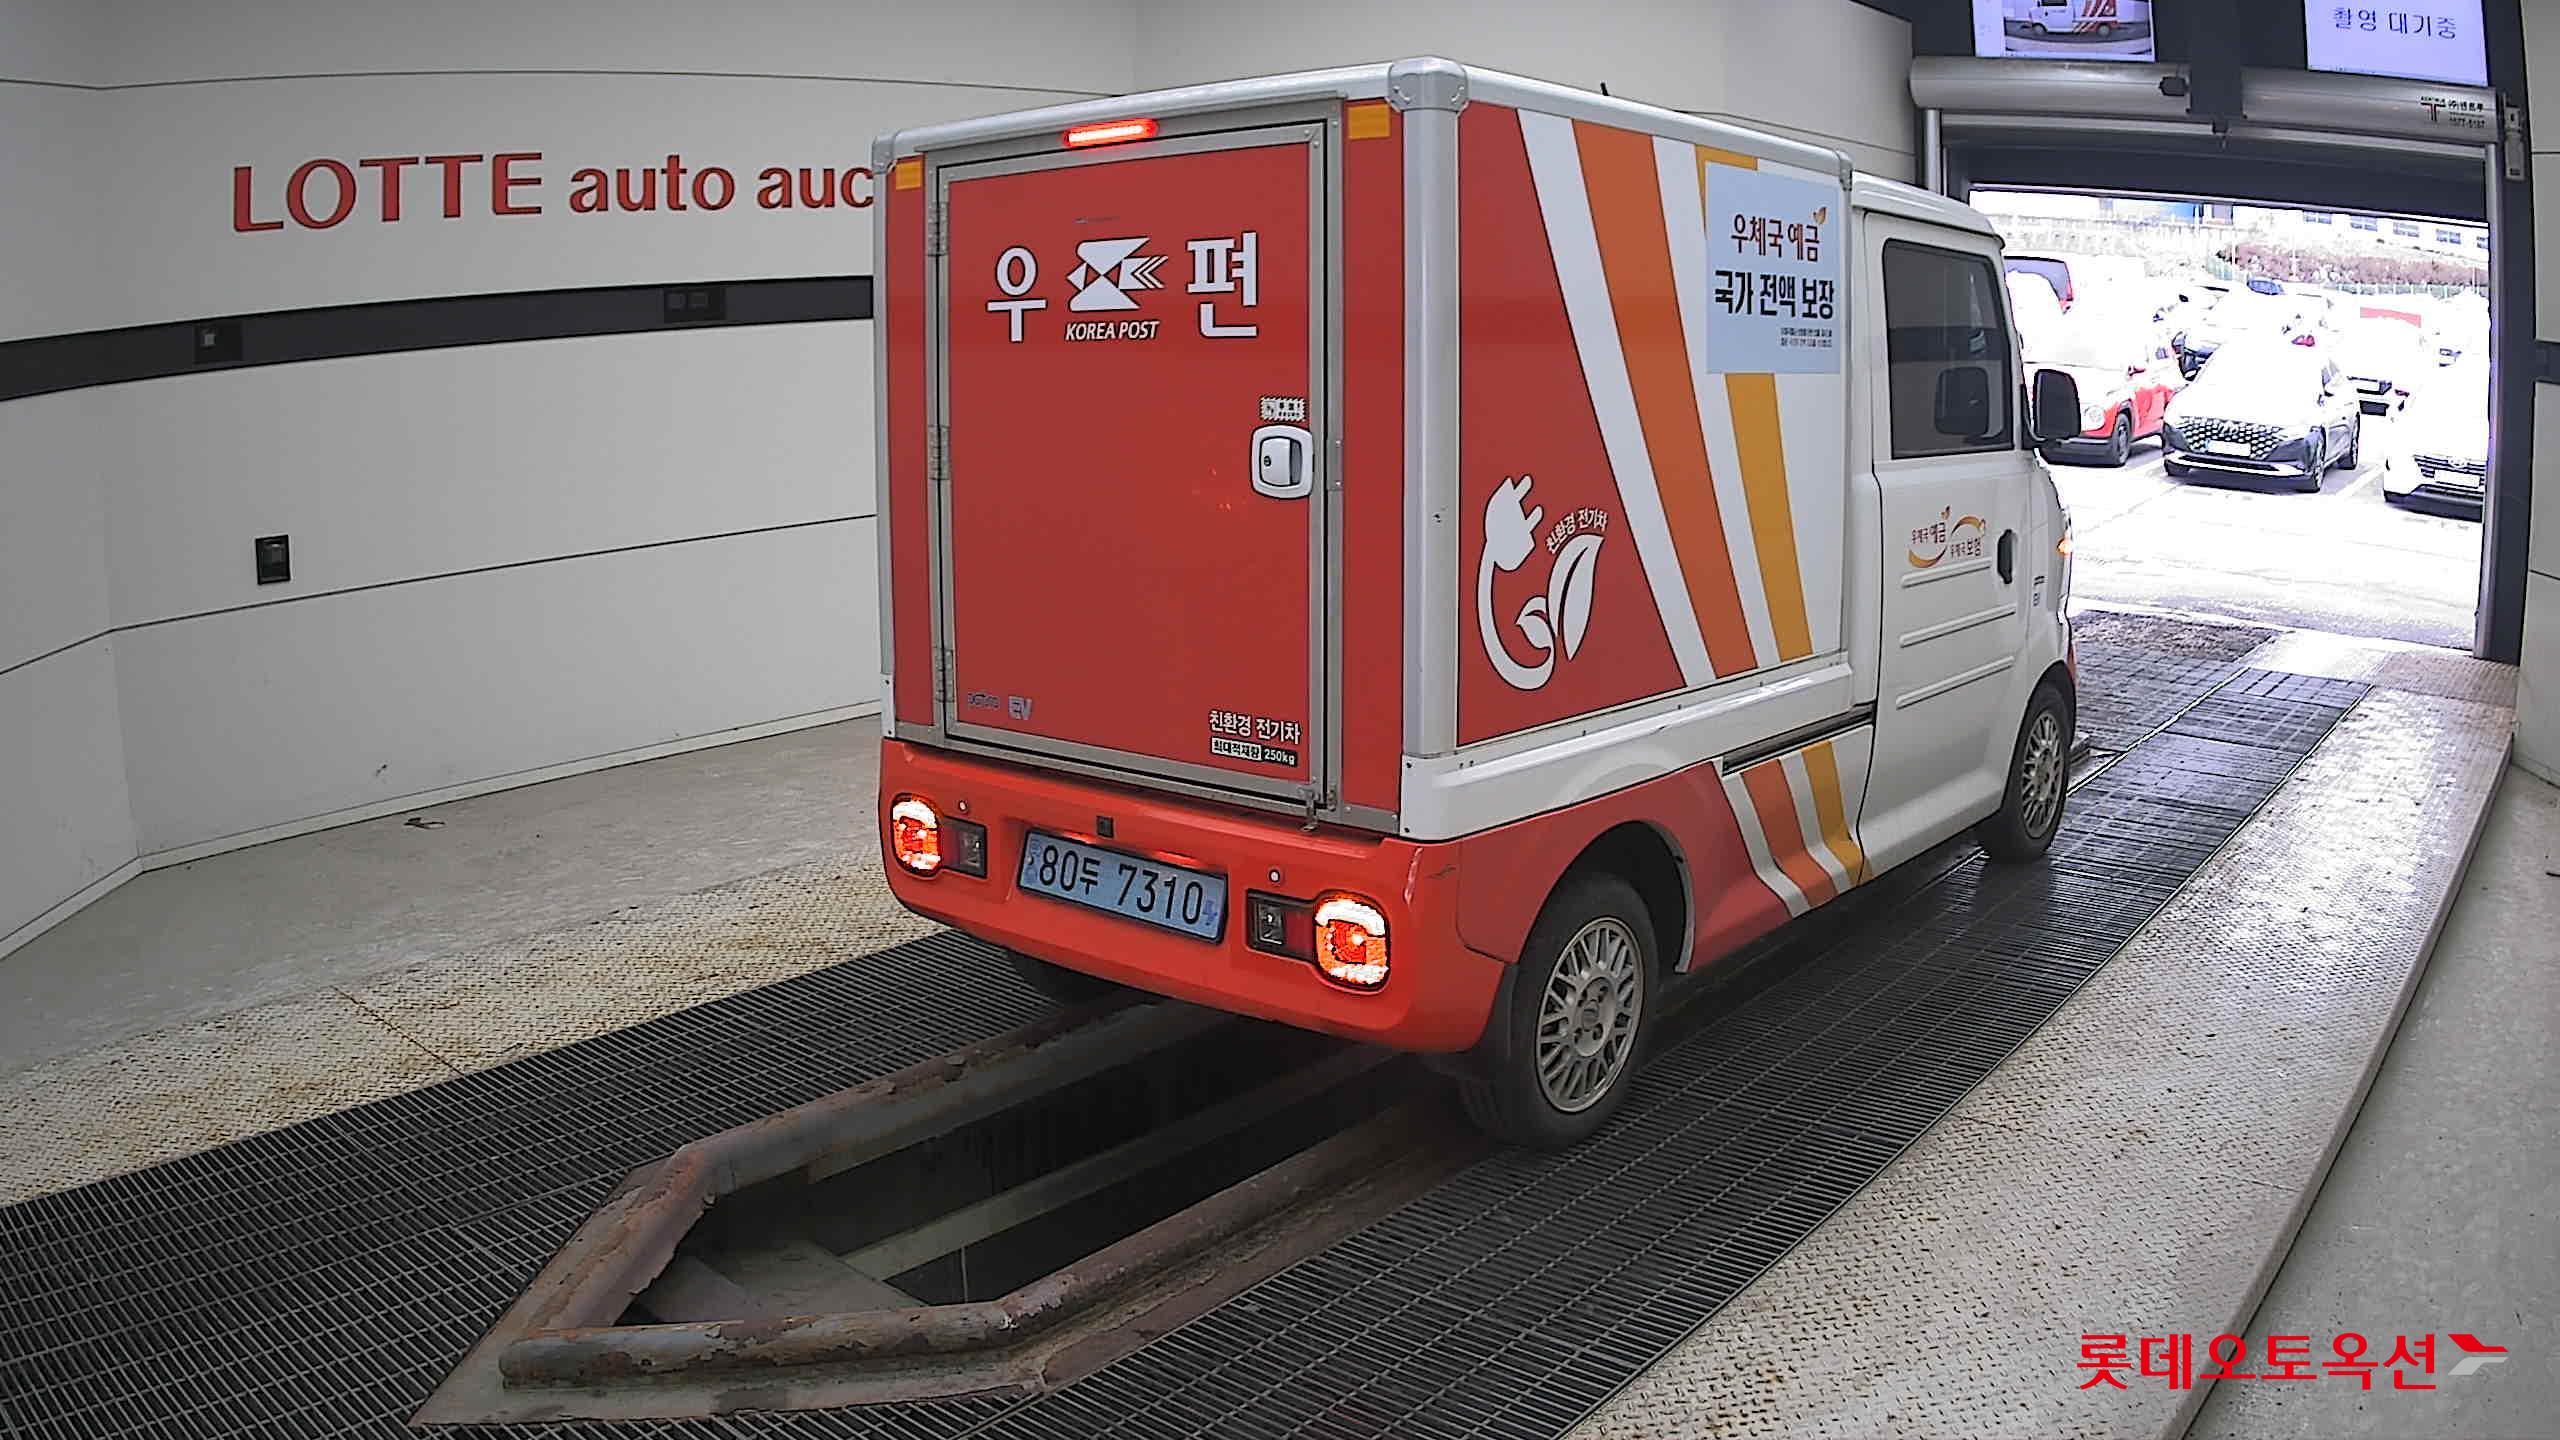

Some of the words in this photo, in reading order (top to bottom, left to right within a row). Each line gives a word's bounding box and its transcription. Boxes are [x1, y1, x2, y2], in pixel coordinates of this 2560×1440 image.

[2388, 12, 2457, 40] 대기중
[233, 152, 543, 232] LOTTE
[569, 153, 736, 214] auto
[756, 165, 874, 208] auc
[1731, 213, 1784, 259] 우체국
[1787, 222, 1820, 263] 예금
[986, 245, 1048, 343] 우
[1185, 230, 1258, 338] 편
[1714, 268, 1754, 315] 국가
[1759, 273, 1796, 318] 전액
[1802, 277, 1835, 319] 보장
[1065, 321, 1117, 341] KOREA
[1118, 320, 1161, 340] POST
[1545, 512, 1576, 554] 친환경
[1577, 508, 1608, 532] 전기차
[1209, 710, 1251, 737] 친환경
[1256, 718, 1301, 745] 전기차
[1264, 748, 1296, 766] 250kg
[1040, 845, 1100, 895] 80두
[1117, 863, 1203, 925] 7310
